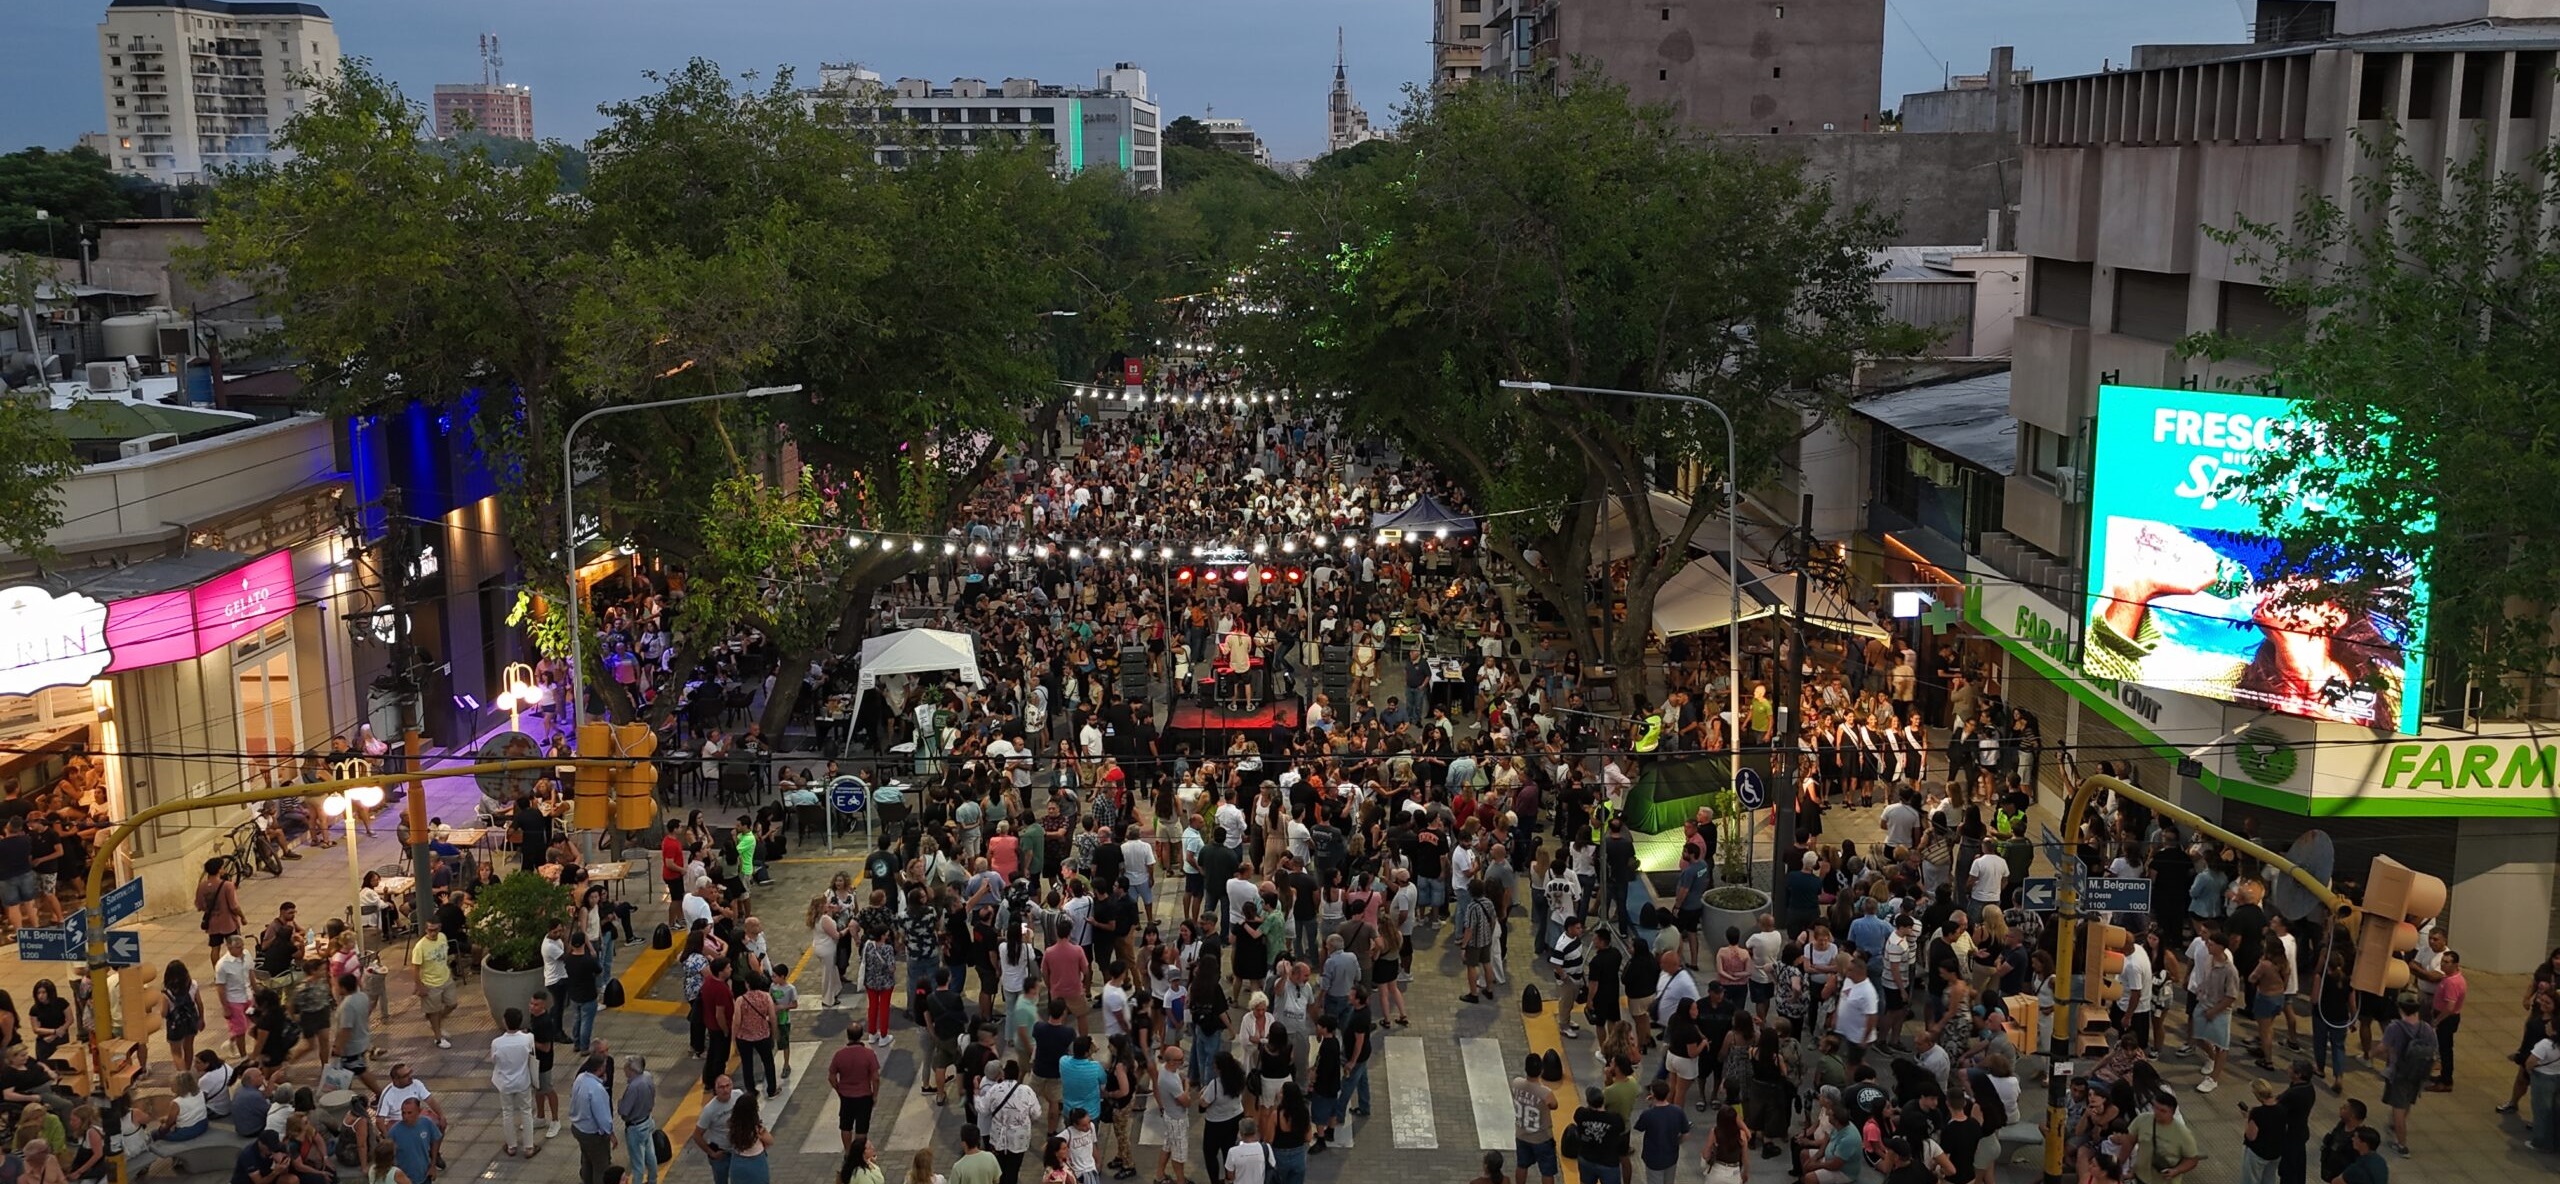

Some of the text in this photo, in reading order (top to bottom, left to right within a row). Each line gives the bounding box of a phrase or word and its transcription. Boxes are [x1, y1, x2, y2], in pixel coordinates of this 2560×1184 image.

[2153, 408, 2368, 458] FRESC
[224, 588, 269, 617] GELATO
[2121, 685, 2163, 725] CIVIT
[2381, 744, 2560, 790] FARM
[836, 795, 846, 807] E
[2088, 879, 2146, 892] M. Belgrano
[2129, 902, 2147, 910] 1000
[20, 930, 66, 942] M. Belgra
